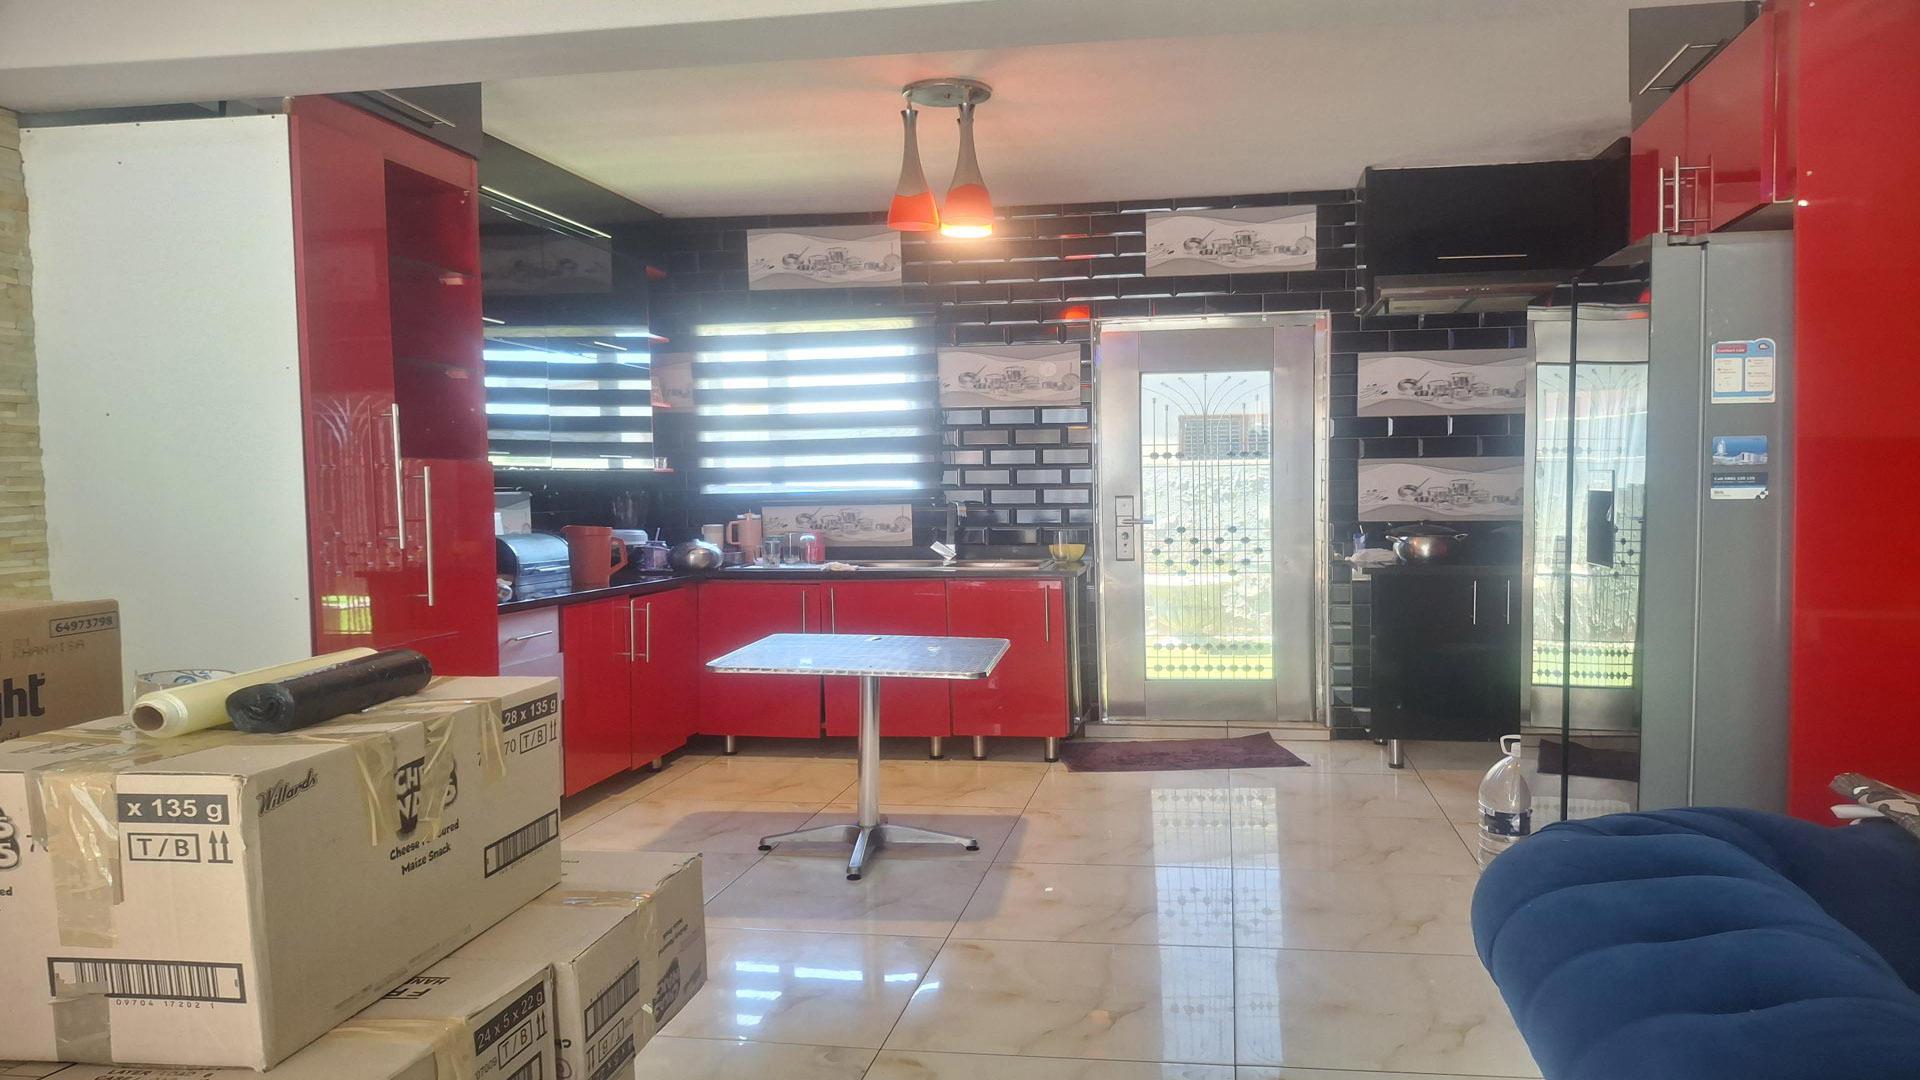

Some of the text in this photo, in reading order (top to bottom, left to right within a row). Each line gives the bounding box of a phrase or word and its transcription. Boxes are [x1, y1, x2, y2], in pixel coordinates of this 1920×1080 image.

[55, 616, 113, 633] 64973798
[504, 699, 556, 726] 28 x 135 g
[256, 768, 319, 817] Willards
[127, 799, 223, 823] x 135 g
[389, 840, 420, 861] Cheese
[401, 842, 451, 876] Maize Snack
[164, 1000, 200, 1008] 17202
[477, 991, 543, 1049] 24 x 5 x 22 g
